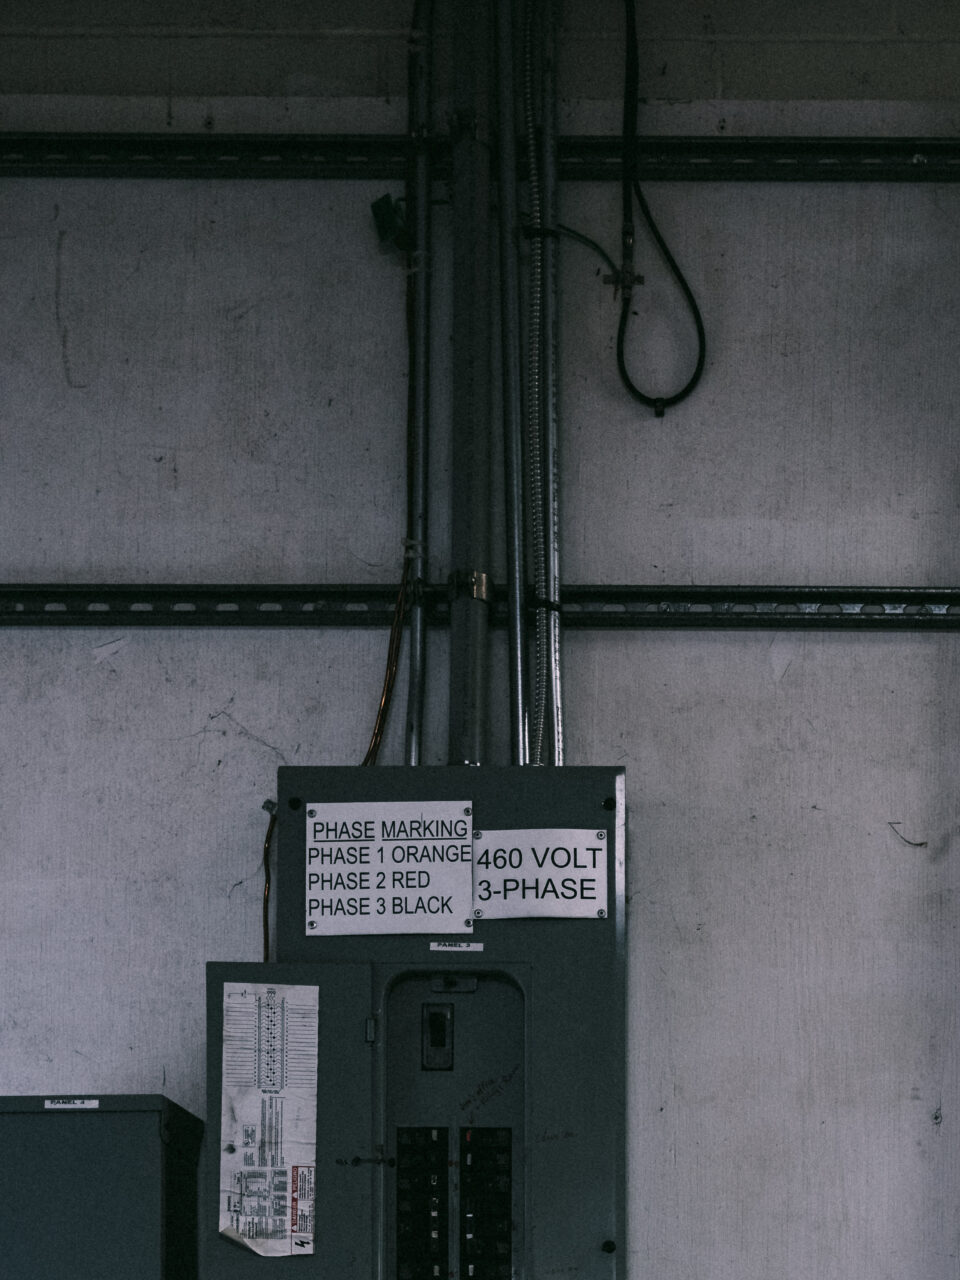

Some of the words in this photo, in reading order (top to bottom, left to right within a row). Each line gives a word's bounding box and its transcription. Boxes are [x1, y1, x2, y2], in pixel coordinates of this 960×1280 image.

[313, 821, 375, 840] PHASE
[381, 819, 468, 838] MARKING
[308, 847, 370, 865] PHASE
[377, 846, 384, 863] 1
[392, 845, 472, 863] ORANGE
[476, 848, 523, 869] 460
[531, 847, 603, 869] VOLT
[308, 872, 370, 890] PHASE
[376, 872, 386, 889] 2
[392, 871, 431, 889] RED
[478, 877, 597, 901] 3-PHASE
[308, 898, 370, 916] PHASE
[376, 897, 387, 915] 3
[392, 896, 453, 915] BLACK
